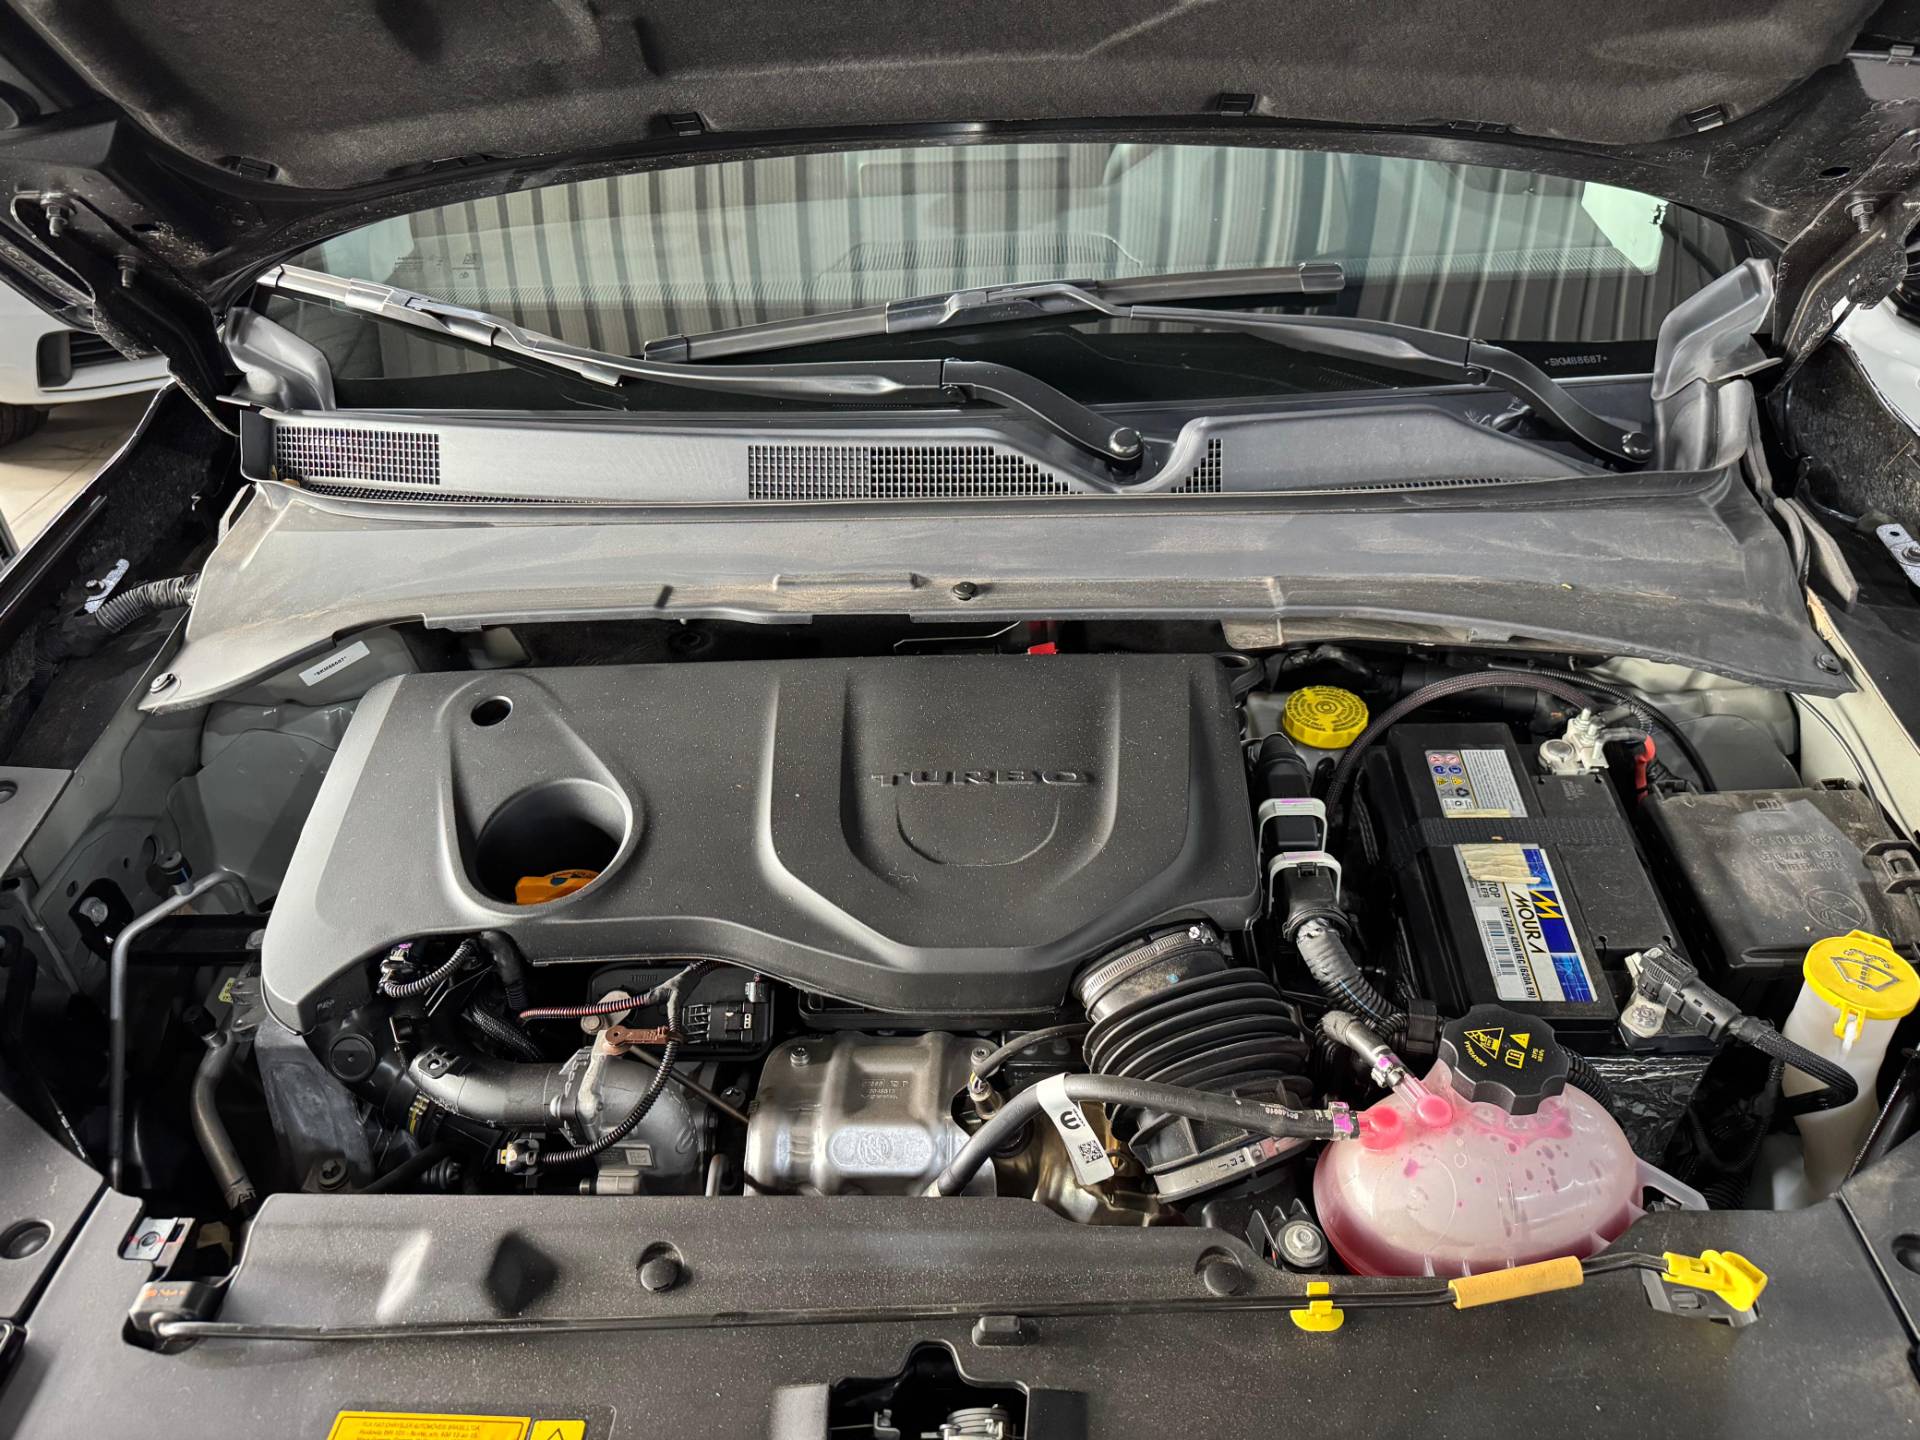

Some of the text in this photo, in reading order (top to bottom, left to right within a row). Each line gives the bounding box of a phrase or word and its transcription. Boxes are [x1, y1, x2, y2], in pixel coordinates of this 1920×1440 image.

[871, 770, 1089, 787] TURBO
[1500, 907, 1511, 920] 12V
[1516, 953, 1526, 964] IEC
[1526, 987, 1538, 999] EN)
[1511, 891, 1547, 954] MOURA
